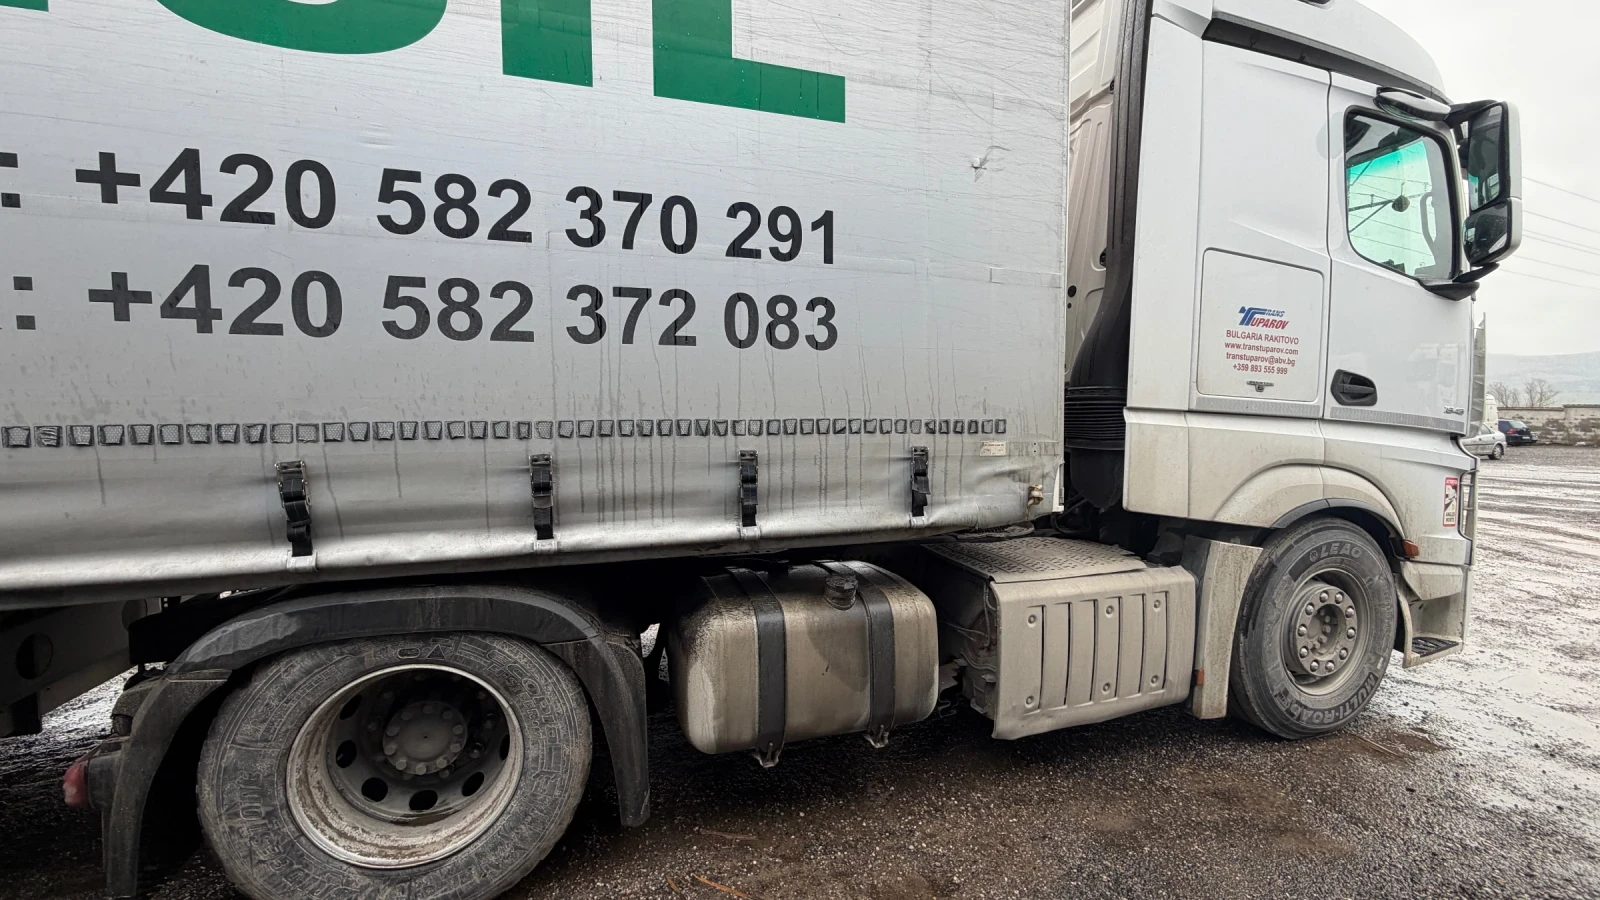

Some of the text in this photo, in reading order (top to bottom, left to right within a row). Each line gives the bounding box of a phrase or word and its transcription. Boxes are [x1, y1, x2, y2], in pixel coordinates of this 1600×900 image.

[76, 148, 336, 229] +420
[376, 168, 532, 243] 582
[566, 186, 698, 254] 370
[725, 202, 834, 265] 291
[88, 264, 342, 337] +420
[382, 275, 535, 342] 582
[566, 285, 697, 346] 372
[724, 293, 838, 350] 083
[1226, 329, 1299, 345] BULGARIA RAKITOVO
[1224, 341, 1299, 356] www.transtuparov.com
[1226, 352, 1296, 367] transtuparov@abv.bg
[1233, 363, 1249, 372] +359
[1250, 364, 1262, 373] 893
[1263, 366, 1275, 374] 555
